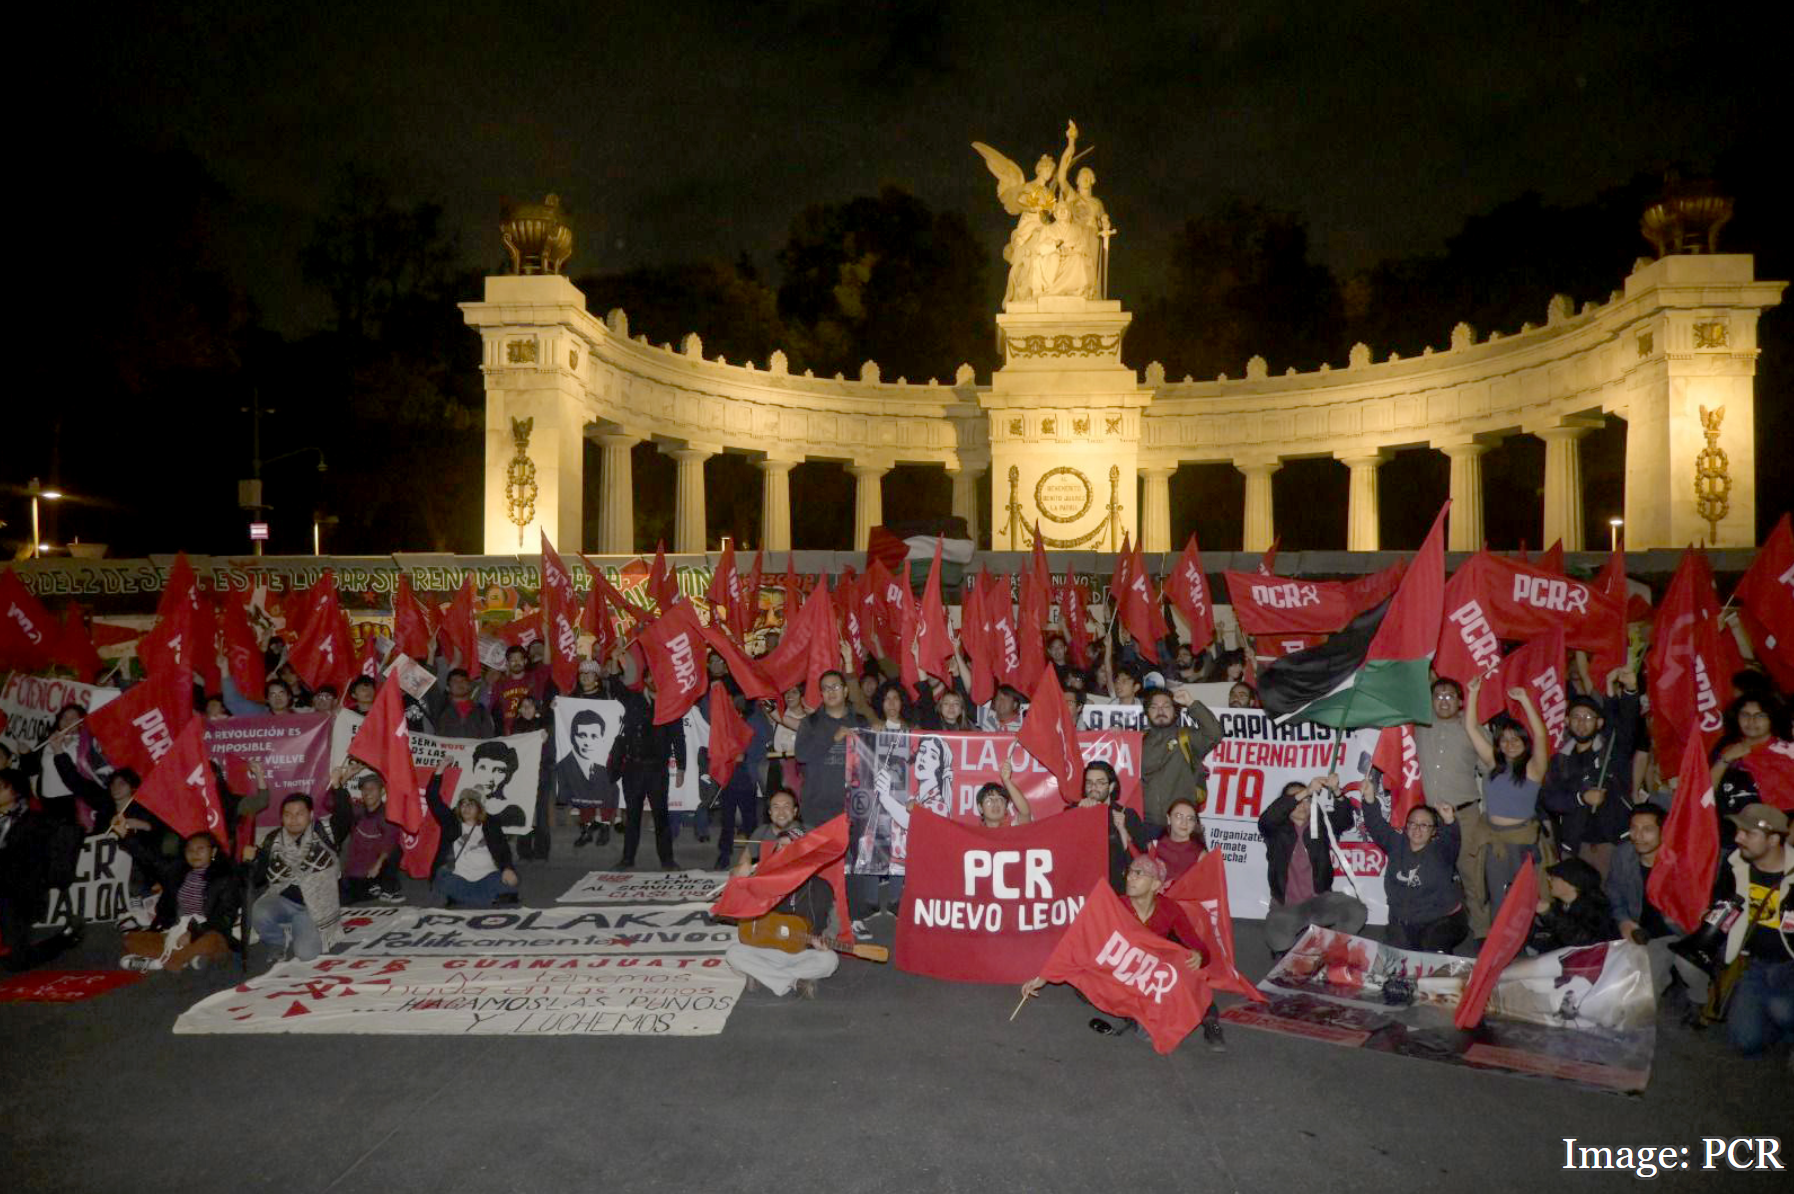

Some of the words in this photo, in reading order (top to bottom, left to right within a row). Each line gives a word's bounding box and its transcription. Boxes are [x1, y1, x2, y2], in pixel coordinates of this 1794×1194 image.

[1252, 583, 1302, 609] PCR
[1514, 573, 1568, 612] PCR
[1450, 599, 1500, 668] PCR
[665, 631, 696, 683] PCR
[132, 706, 174, 765] PCR
[215, 726, 284, 740] REVOLUCIÓN
[288, 727, 301, 736] ES
[265, 754, 305, 765] VUELVE
[428, 748, 446, 757] LAS
[962, 737, 1000, 772] LA
[1213, 740, 1347, 768] ALTERNATIVA
[964, 849, 1054, 899] PCR
[1222, 852, 1248, 864] ucha!
[914, 898, 1002, 932] NUEVO
[1018, 896, 1085, 931] LEON
[443, 958, 725, 970] GUANAJUATO
[1096, 930, 1157, 996] PCR
